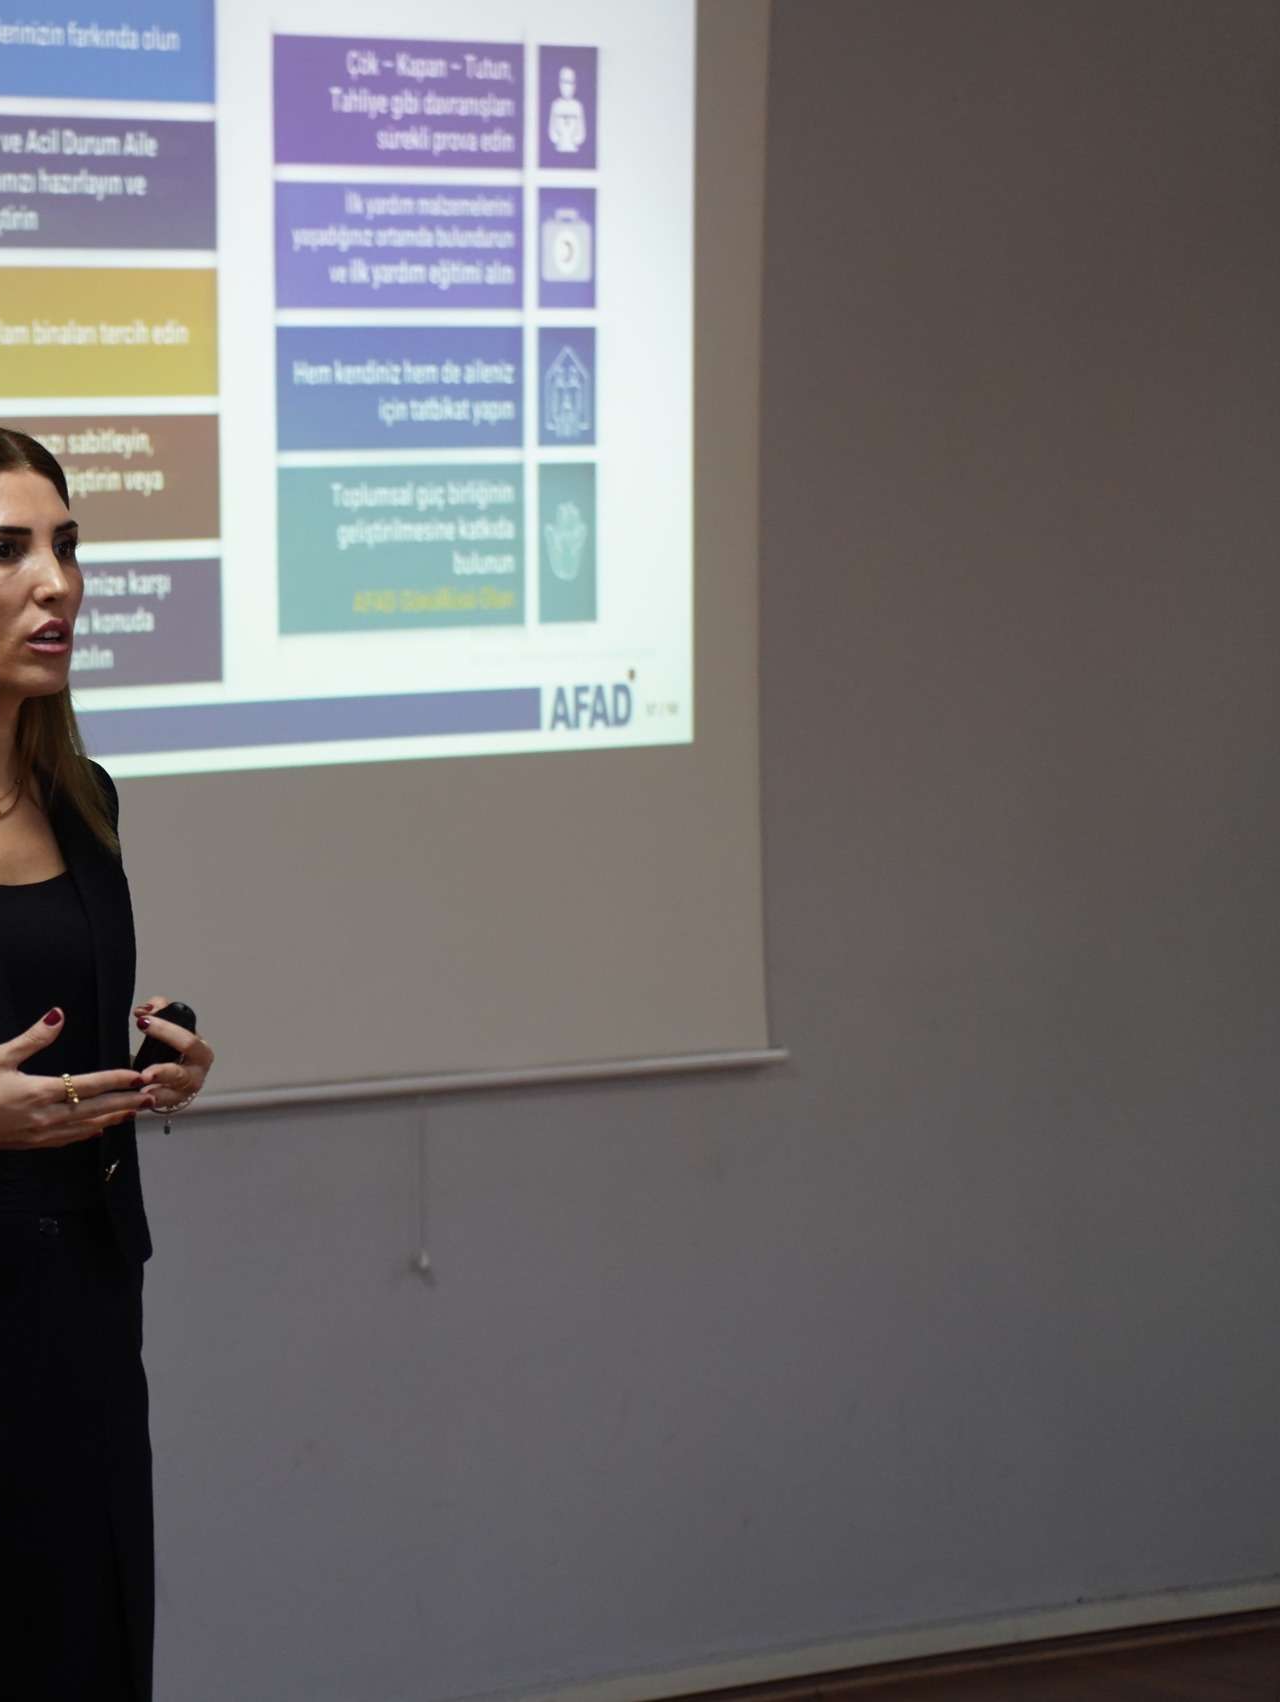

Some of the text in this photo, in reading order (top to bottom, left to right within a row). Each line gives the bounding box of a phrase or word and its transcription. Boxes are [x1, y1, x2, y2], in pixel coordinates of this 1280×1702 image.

[0, 133, 23, 153] ve
[25, 129, 60, 154] Acil
[62, 129, 120, 155] Durum
[123, 131, 158, 157] Aile
[125, 175, 148, 195] ve
[152, 319, 190, 345] edin
[292, 360, 333, 385] Hem
[403, 359, 439, 384] hem
[441, 360, 461, 384] de
[122, 470, 164, 497] veya
[550, 683, 632, 730] AFAD
